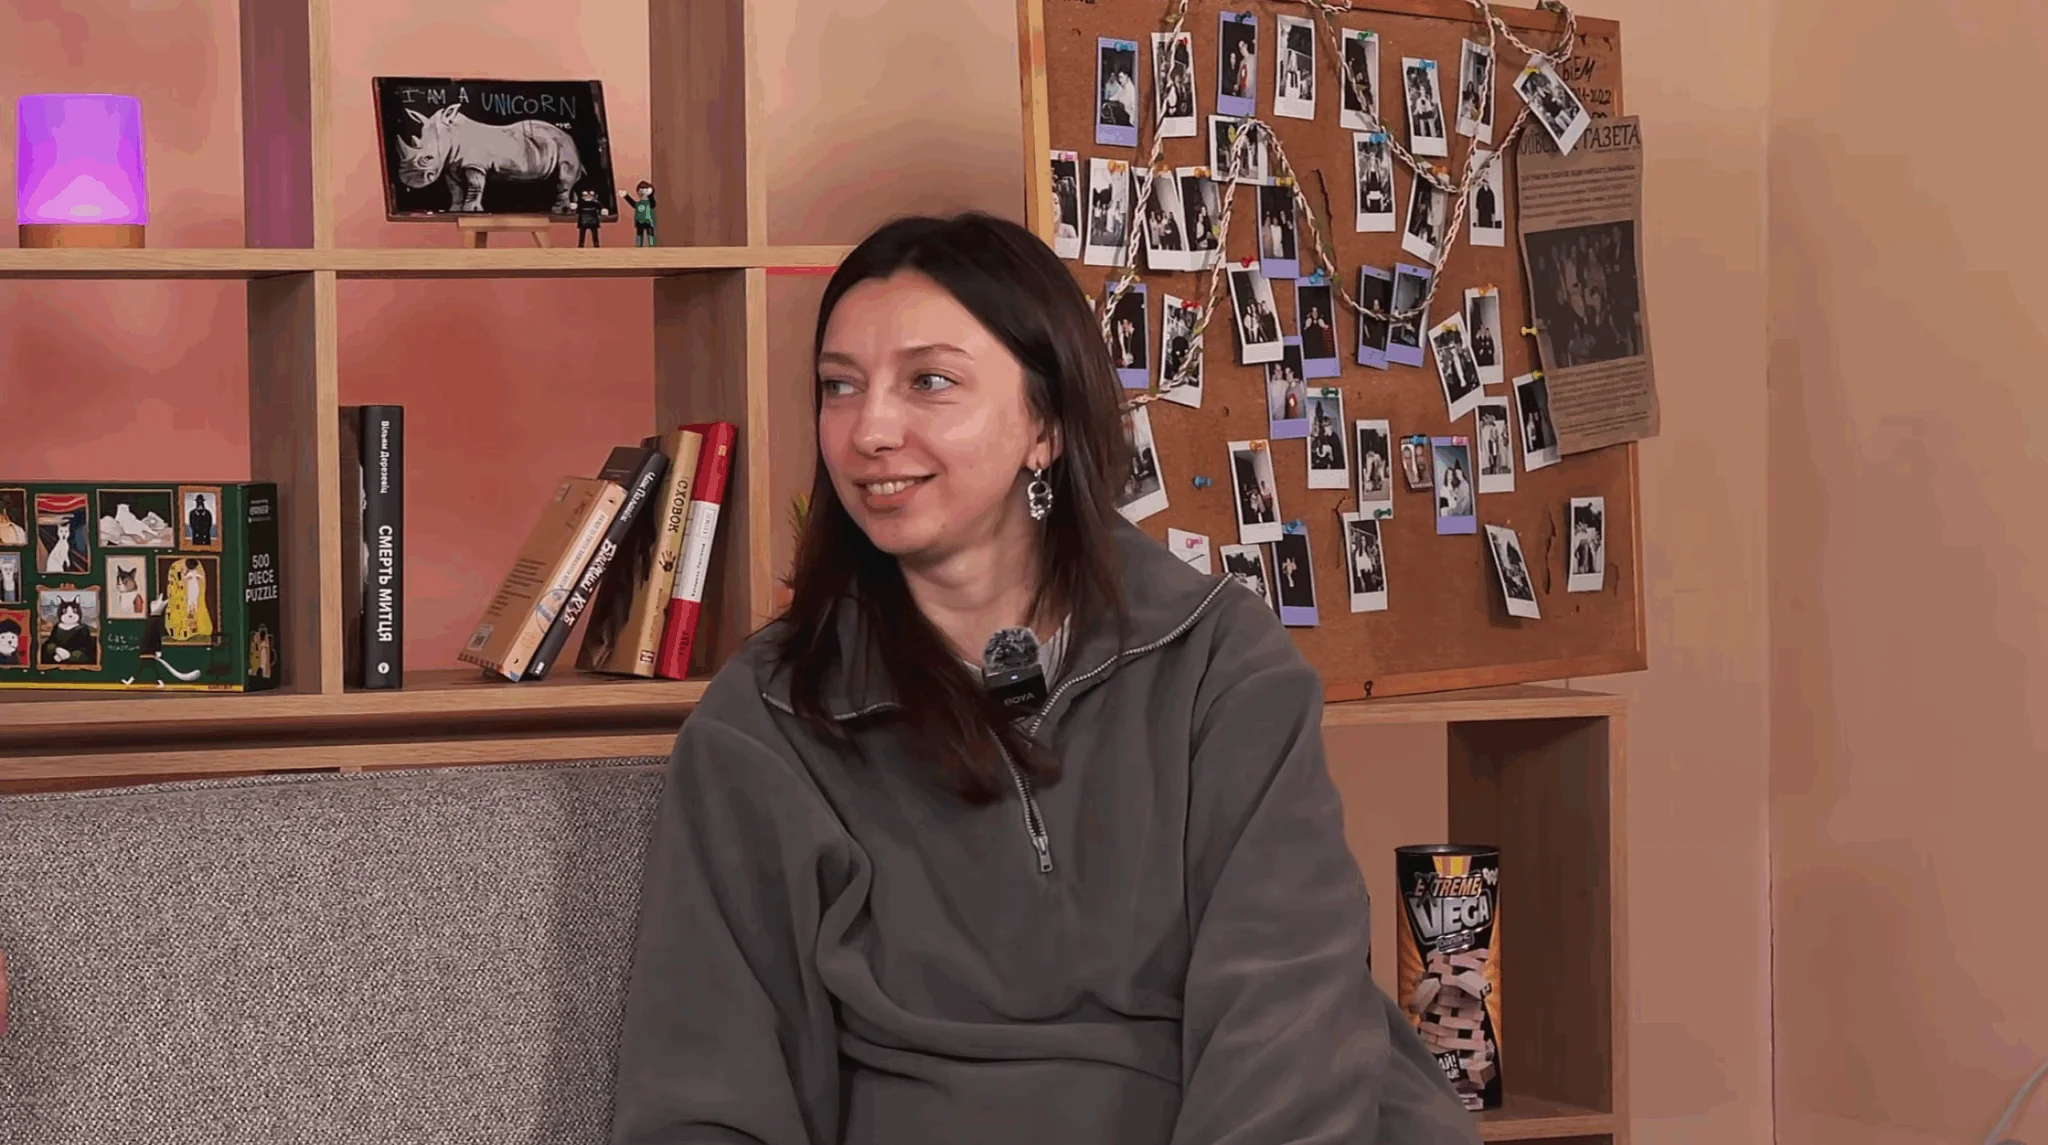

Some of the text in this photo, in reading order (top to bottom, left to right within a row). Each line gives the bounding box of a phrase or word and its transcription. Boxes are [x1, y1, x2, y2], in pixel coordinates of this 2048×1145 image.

[402, 86, 576, 119] I AM A UNICORN
[1582, 124, 1640, 149] ГАЗЕТА
[380, 420, 390, 450] Вільям
[668, 479, 689, 534] СХОВОК
[252, 553, 270, 569] 500
[248, 569, 275, 586] PIECE
[377, 524, 393, 642] СМЕРТЬ МИТЦЯ
[245, 585, 278, 603] PUZZLE
[1414, 872, 1482, 902] EXTREME
[1409, 895, 1490, 939] VEGA
